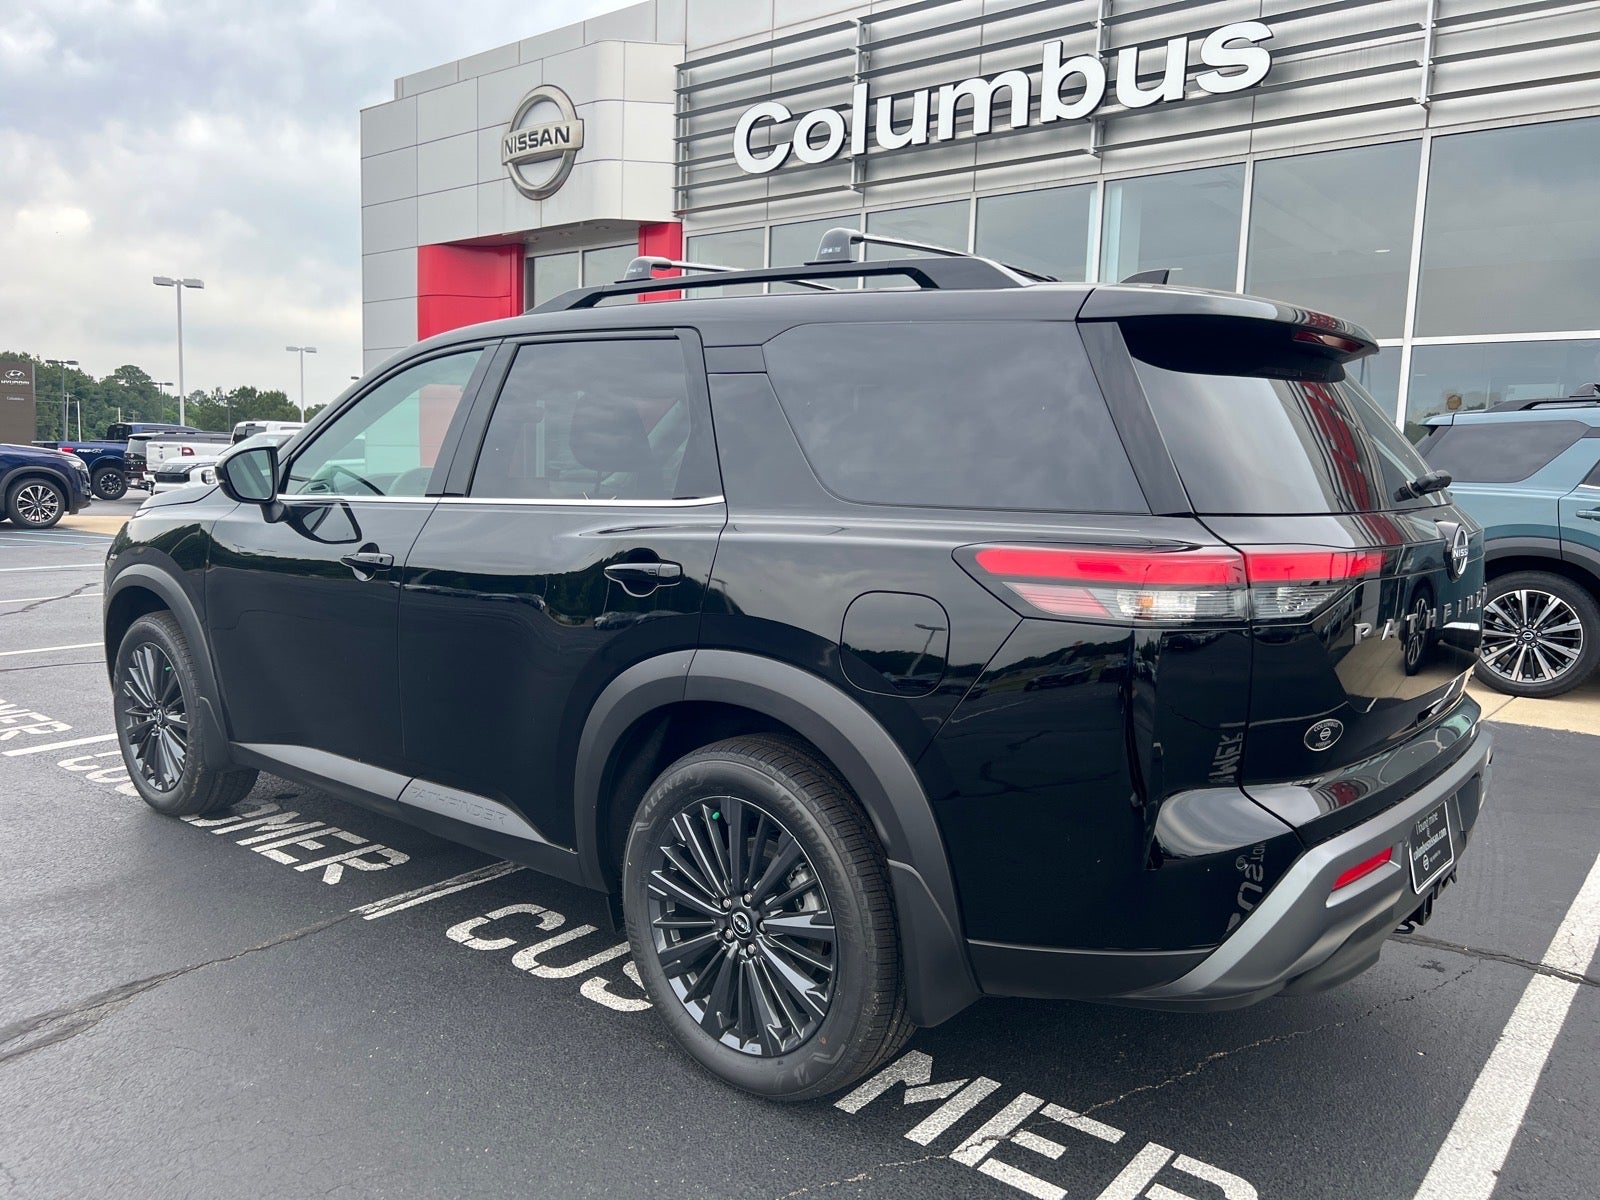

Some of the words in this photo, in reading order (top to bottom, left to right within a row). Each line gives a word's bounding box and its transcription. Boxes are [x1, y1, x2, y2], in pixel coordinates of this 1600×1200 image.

[733, 21, 1274, 174] Columbus
[504, 126, 570, 155] NISSAN
[1453, 548, 1468, 559] NISS
